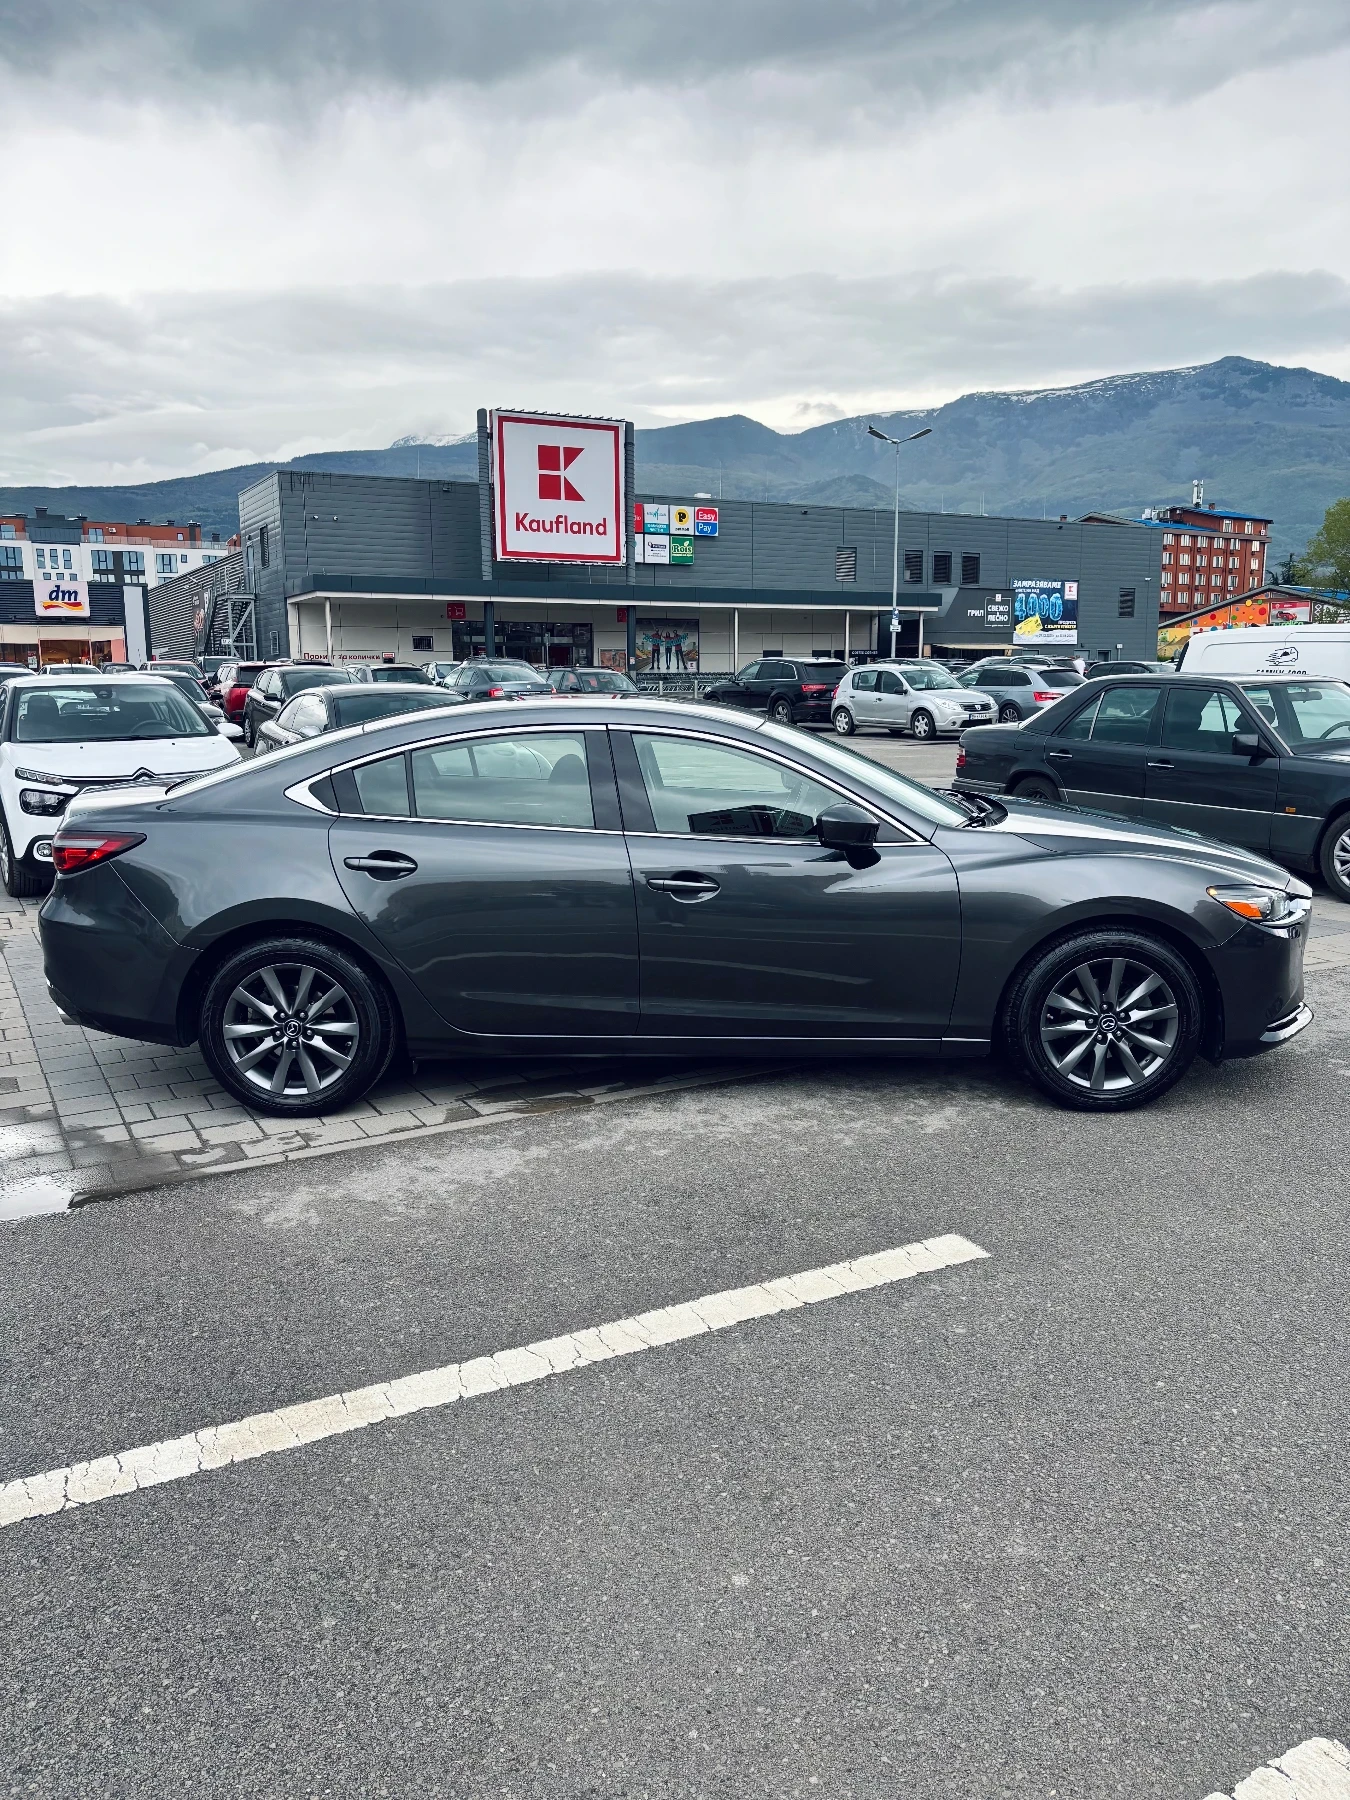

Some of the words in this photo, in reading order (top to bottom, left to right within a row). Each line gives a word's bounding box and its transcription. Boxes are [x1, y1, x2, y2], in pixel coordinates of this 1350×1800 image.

[538, 445, 586, 502] K
[698, 511, 716, 521] Easy
[515, 512, 607, 536] Kaufland
[698, 523, 712, 533] Pay
[672, 544, 693, 553] Rois
[1013, 580, 1061, 588] ЗАМРАЗЯВАМЕ
[48, 585, 78, 601] dm
[1014, 593, 1063, 621] 4000
[967, 609, 984, 617] ГРИЛ
[304, 653, 336, 661] Паркиг
